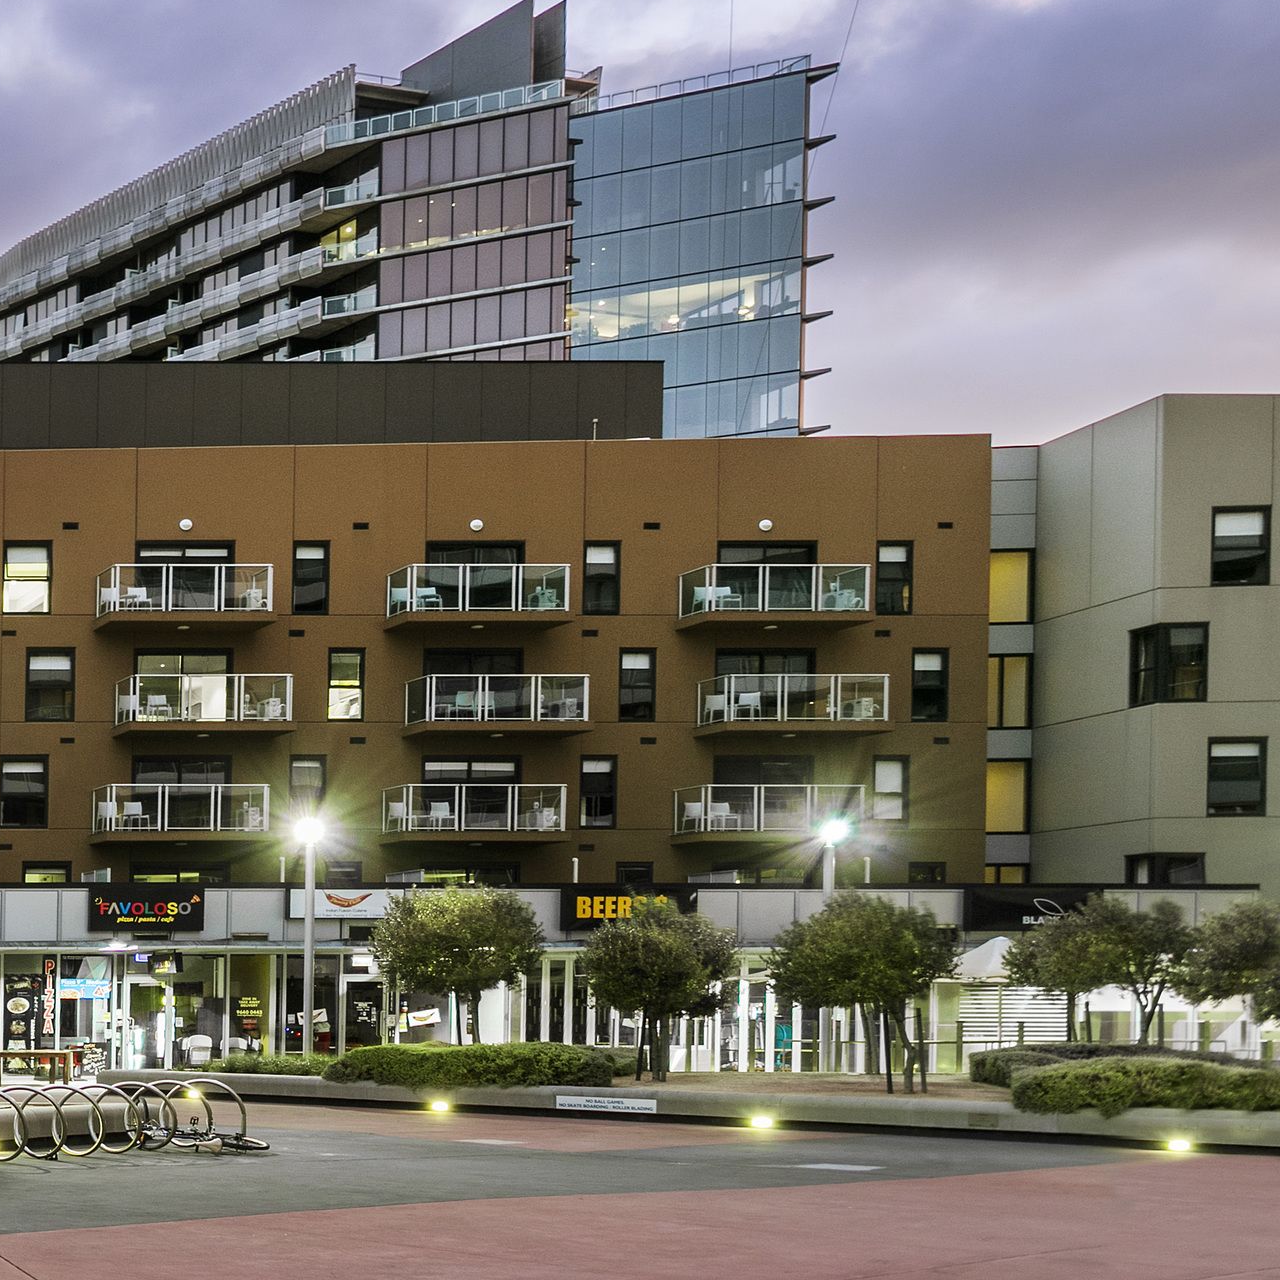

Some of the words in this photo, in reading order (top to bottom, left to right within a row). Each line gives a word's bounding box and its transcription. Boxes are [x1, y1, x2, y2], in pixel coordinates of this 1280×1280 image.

[100, 902, 192, 915] FAVOLOSO
[1022, 916, 1060, 924] BLA
[42, 959, 55, 1034] PIZZA
